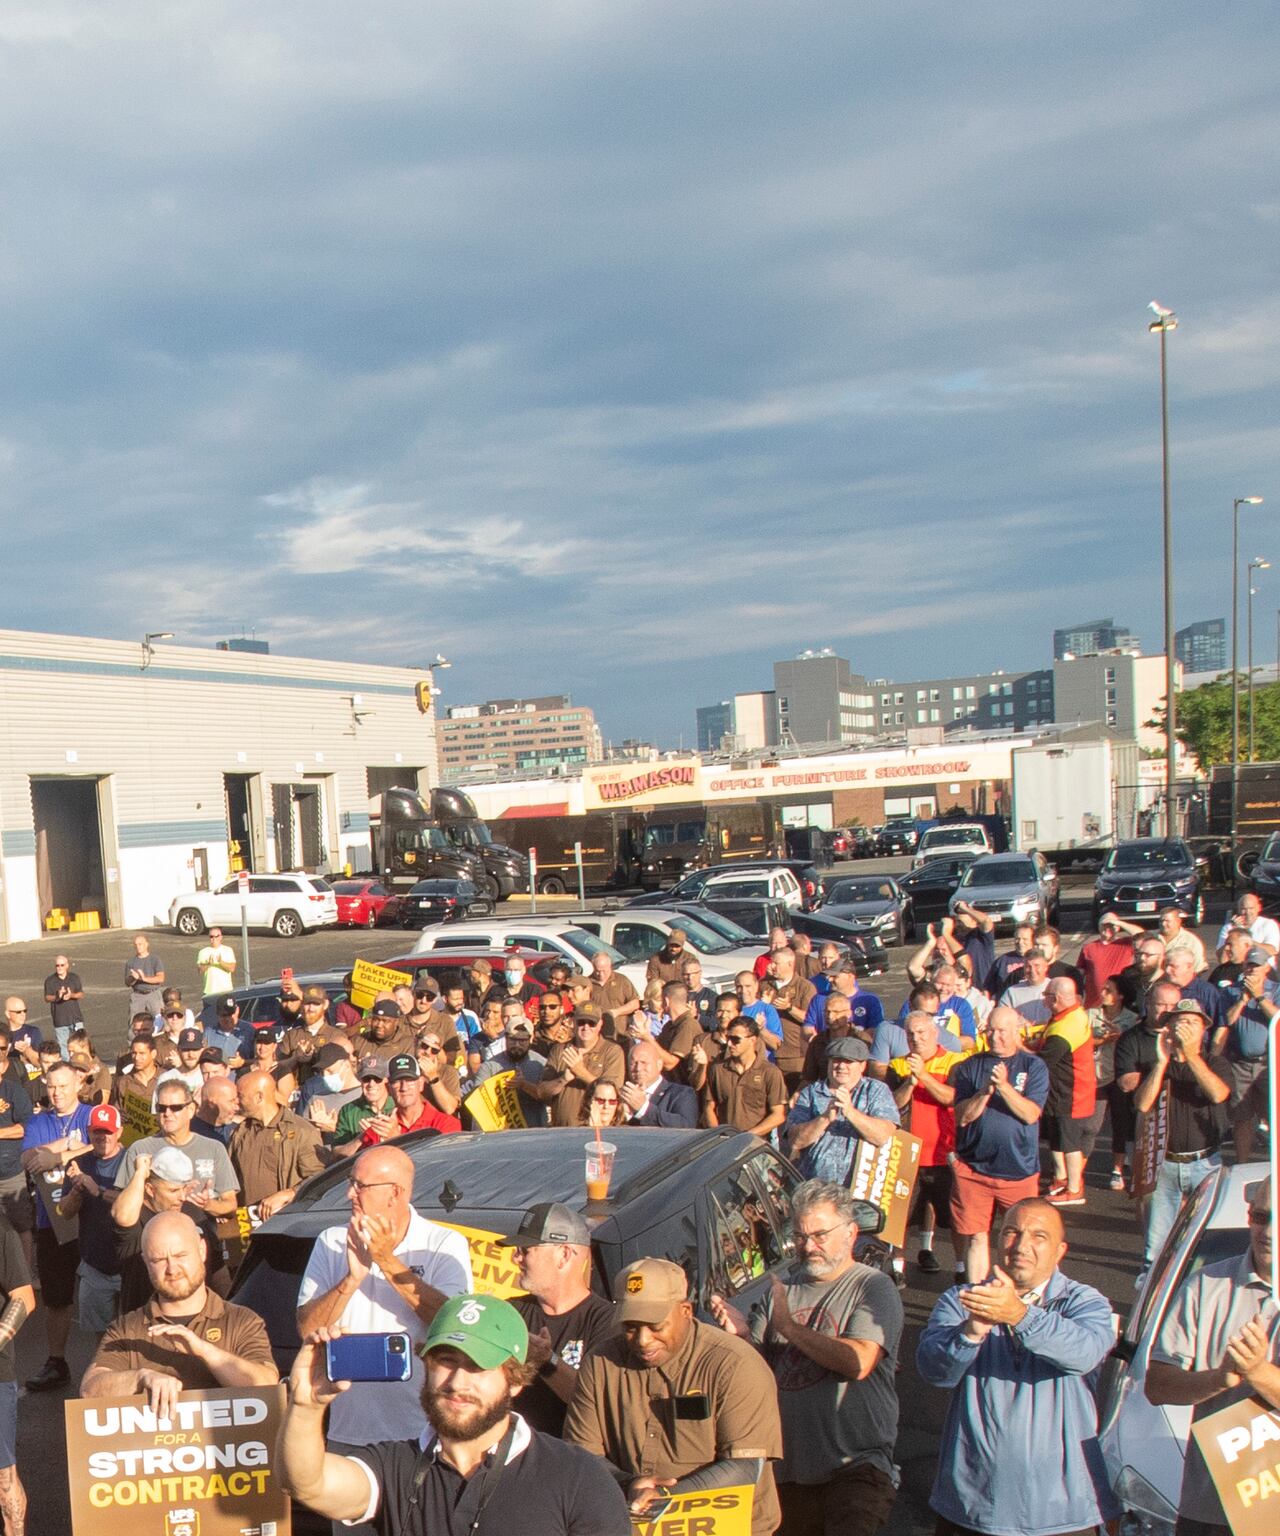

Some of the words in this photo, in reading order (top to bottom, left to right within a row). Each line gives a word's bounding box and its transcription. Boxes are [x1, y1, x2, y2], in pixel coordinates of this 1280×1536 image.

[710, 777, 765, 792] OFFICE
[772, 767, 867, 787] FURNITURE
[875, 760, 971, 779] SHOWROOM
[357, 963, 385, 978] MAKE
[387, 972, 408, 985] UPS
[360, 973, 397, 988] DELIVE
[1156, 1089, 1167, 1168] UNITE
[853, 1141, 876, 1200] NITE
[880, 1136, 903, 1216] ONTRACT
[468, 1237, 503, 1261] KE
[154, 1433, 186, 1446] FOR
[189, 1431, 201, 1443] A
[88, 1441, 269, 1478] STRONG
[88, 1469, 271, 1508] CONTRACT
[1236, 1464, 1280, 1508] PA
[169, 1508, 195, 1520] UPS
